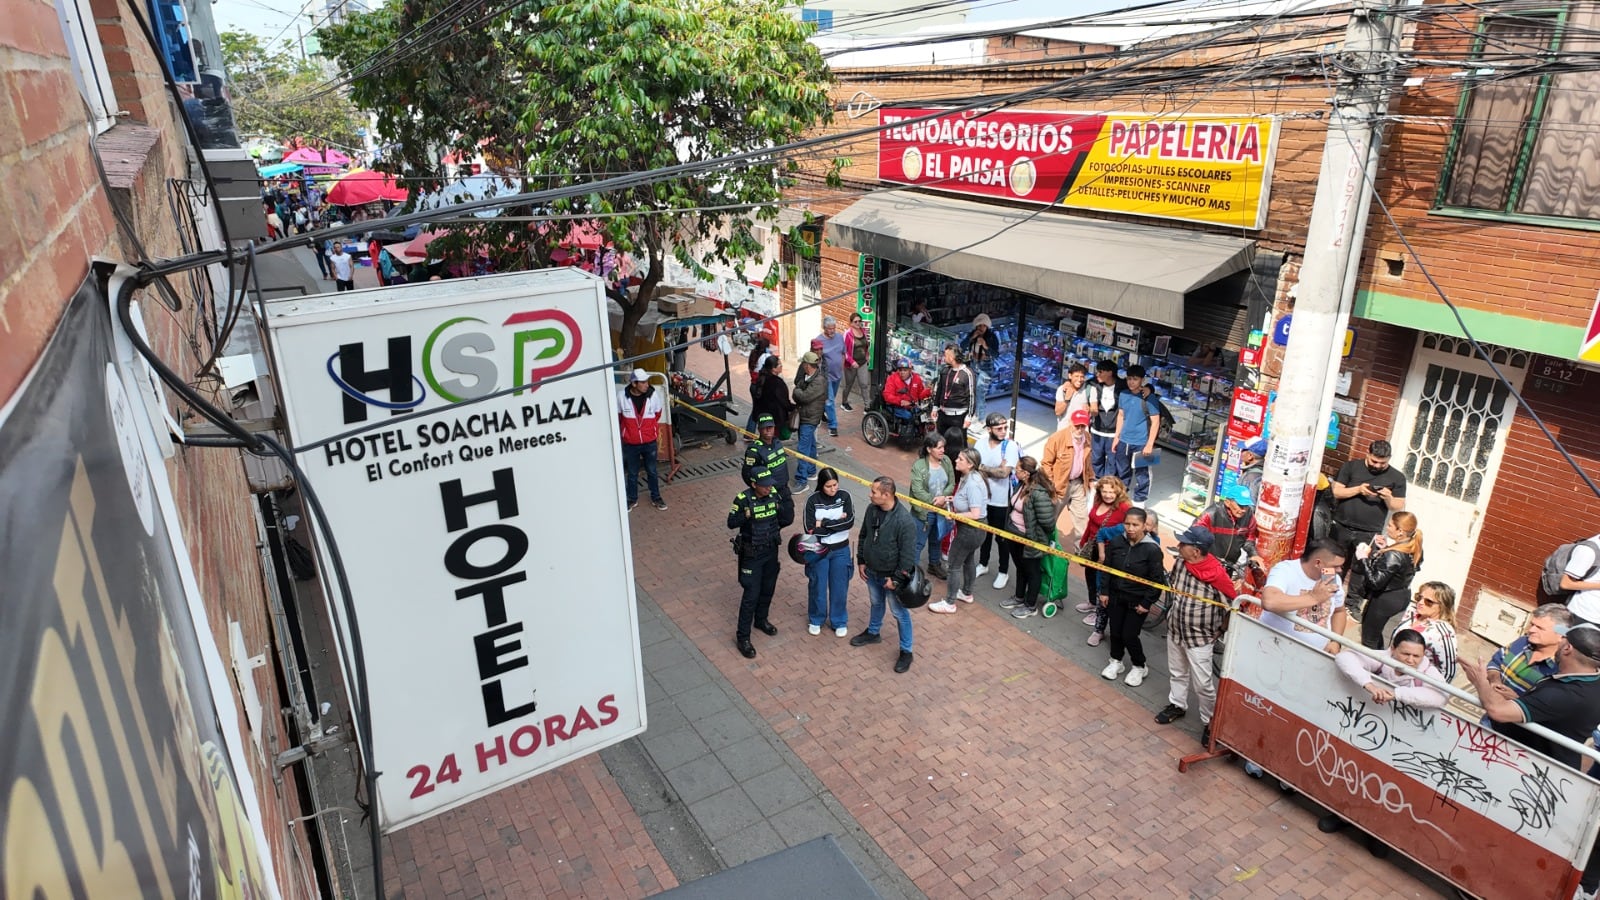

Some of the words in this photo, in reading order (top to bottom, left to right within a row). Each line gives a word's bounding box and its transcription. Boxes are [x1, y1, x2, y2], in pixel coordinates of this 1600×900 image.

[884, 115, 1073, 155] TECNOACCESORIOS
[1108, 119, 1262, 164] PAPELERIA
[925, 152, 944, 178] EL
[950, 155, 1006, 187] PAISA
[1089, 161, 1176, 177] FOTOCOPIAS-UTILES
[1177, 168, 1233, 182] ESCOLARES
[1078, 185, 1161, 203] DETALLES-PELUCHES
[1208, 198, 1232, 212] MAS
[861, 256, 877, 314] SERVICIO
[1239, 392, 1259, 403] Claro
[324, 428, 412, 467] HOTEL
[417, 410, 516, 444] SOACHA
[522, 396, 593, 427] PLAZA
[366, 462, 384, 483] El
[387, 449, 454, 477] Confort
[459, 442, 494, 465] Que
[497, 431, 567, 457] Mereces.
[439, 467, 538, 728] HOTEL
[405, 752, 463, 800] 24
[475, 694, 620, 773] HORAS
